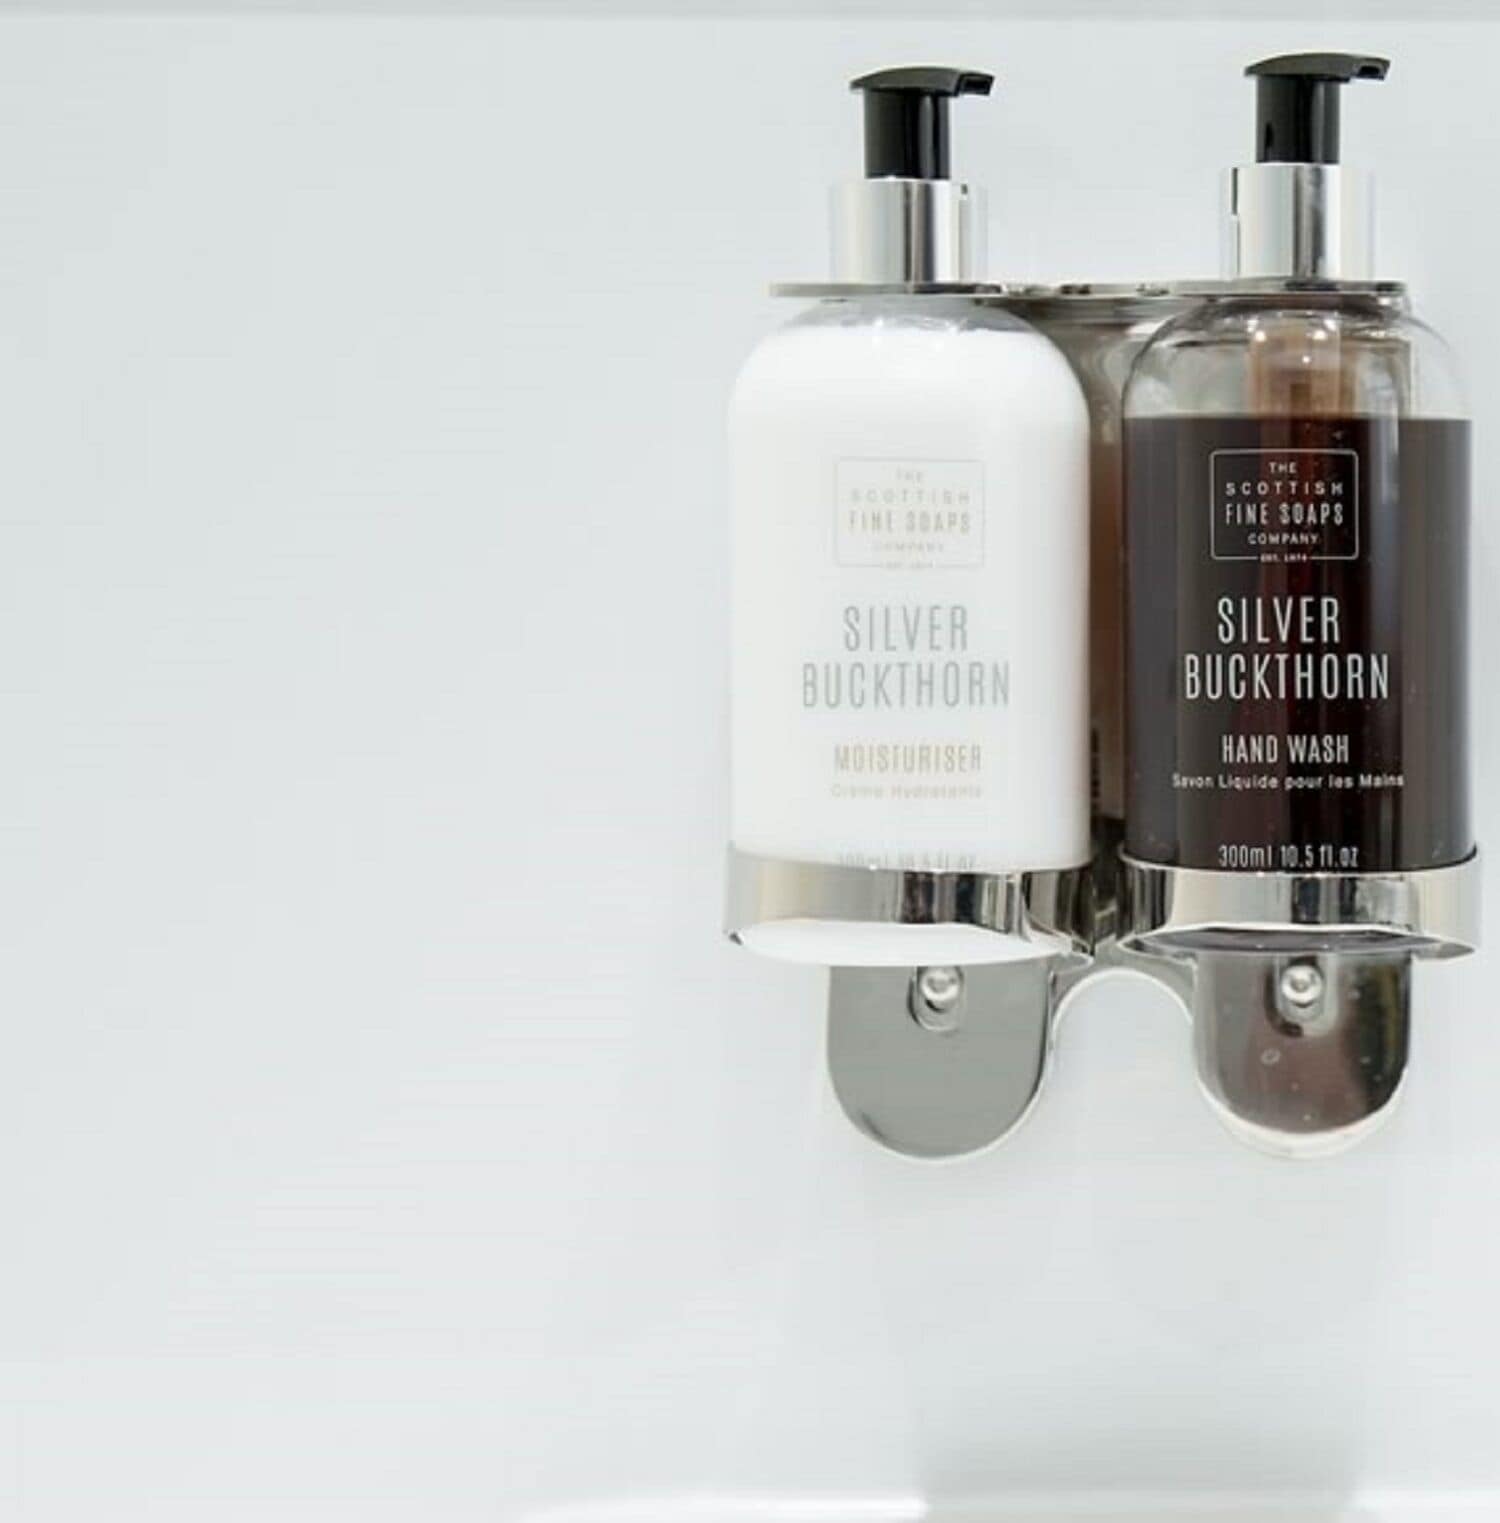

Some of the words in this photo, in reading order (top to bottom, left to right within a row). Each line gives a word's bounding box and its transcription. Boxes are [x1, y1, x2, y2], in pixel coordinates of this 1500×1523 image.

[1268, 463, 1297, 473] THE
[850, 490, 970, 504] SCOTTISH
[1226, 482, 1344, 495] SCOTTISH
[849, 510, 894, 533] FINE
[906, 510, 971, 533] SOAPS
[1226, 503, 1269, 525] FINE
[1279, 503, 1344, 525] SOAPS
[1248, 533, 1319, 545] COMPANY
[843, 605, 968, 652] SILVER
[1218, 597, 1340, 644] SILVER
[803, 661, 1010, 708] BUCKTHORN
[1185, 654, 1389, 700] BUCKTHORN
[834, 744, 982, 773] MOISTURISER
[1222, 735, 1278, 764] HAND
[1287, 735, 1349, 764] WASH
[1172, 773, 1214, 788] Savon
[1219, 773, 1278, 789] Liquide
[1285, 774, 1324, 789] pour
[1329, 774, 1354, 788] les
[1359, 774, 1404, 788] Mains
[1219, 844, 1272, 867] 300ml
[1280, 844, 1313, 867] 10.5
